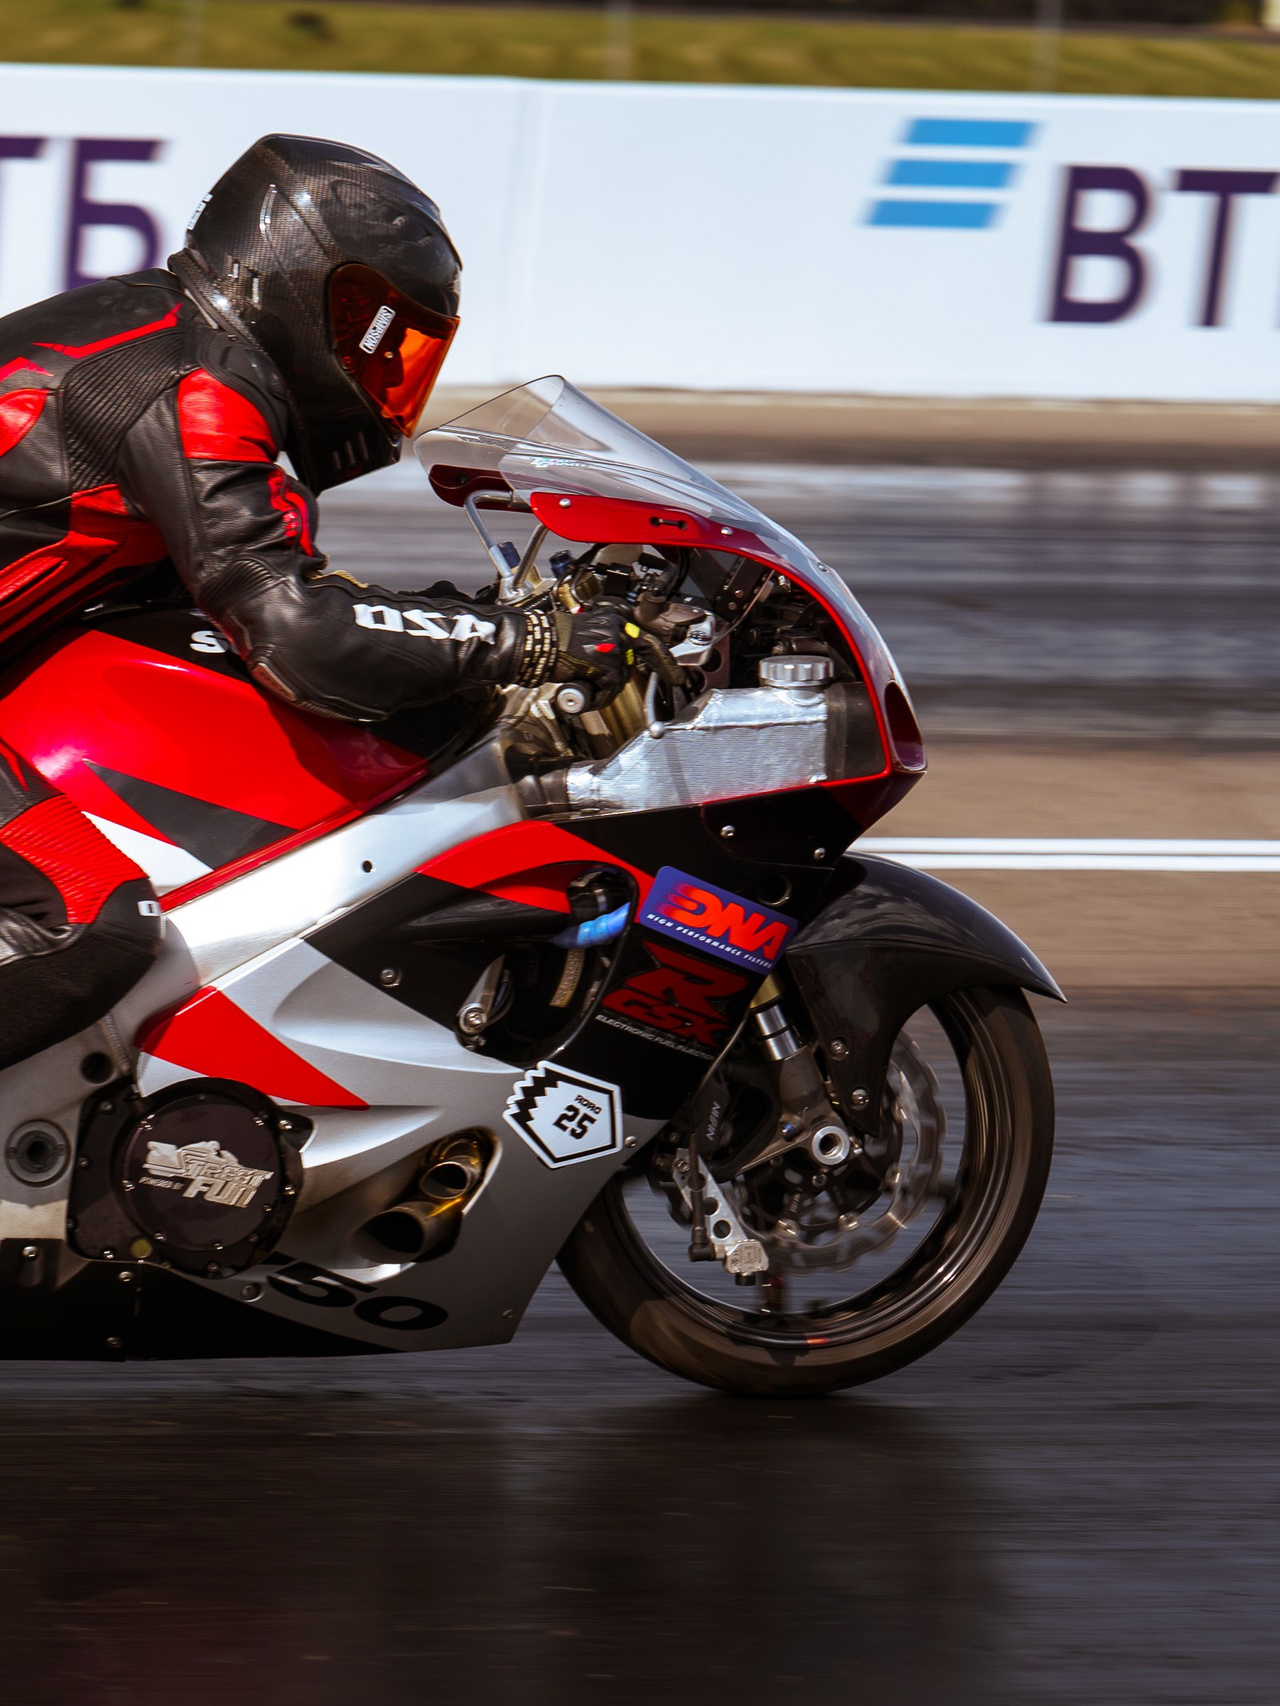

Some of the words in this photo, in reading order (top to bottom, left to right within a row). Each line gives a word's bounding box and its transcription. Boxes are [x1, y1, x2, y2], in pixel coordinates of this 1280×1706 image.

[1043, 163, 1280, 328] ВТ
[362, 307, 393, 352] SIMPSON
[646, 913, 674, 928] HIGH
[675, 926, 742, 957] PERFORMANCE
[743, 954, 773, 969] FILTERS
[657, 882, 789, 960] DNA
[595, 1014, 655, 1041] ELECTRONIC
[654, 1036, 679, 1050] FUEL
[552, 1103, 597, 1140] 25
[262, 1251, 450, 1331] 50
